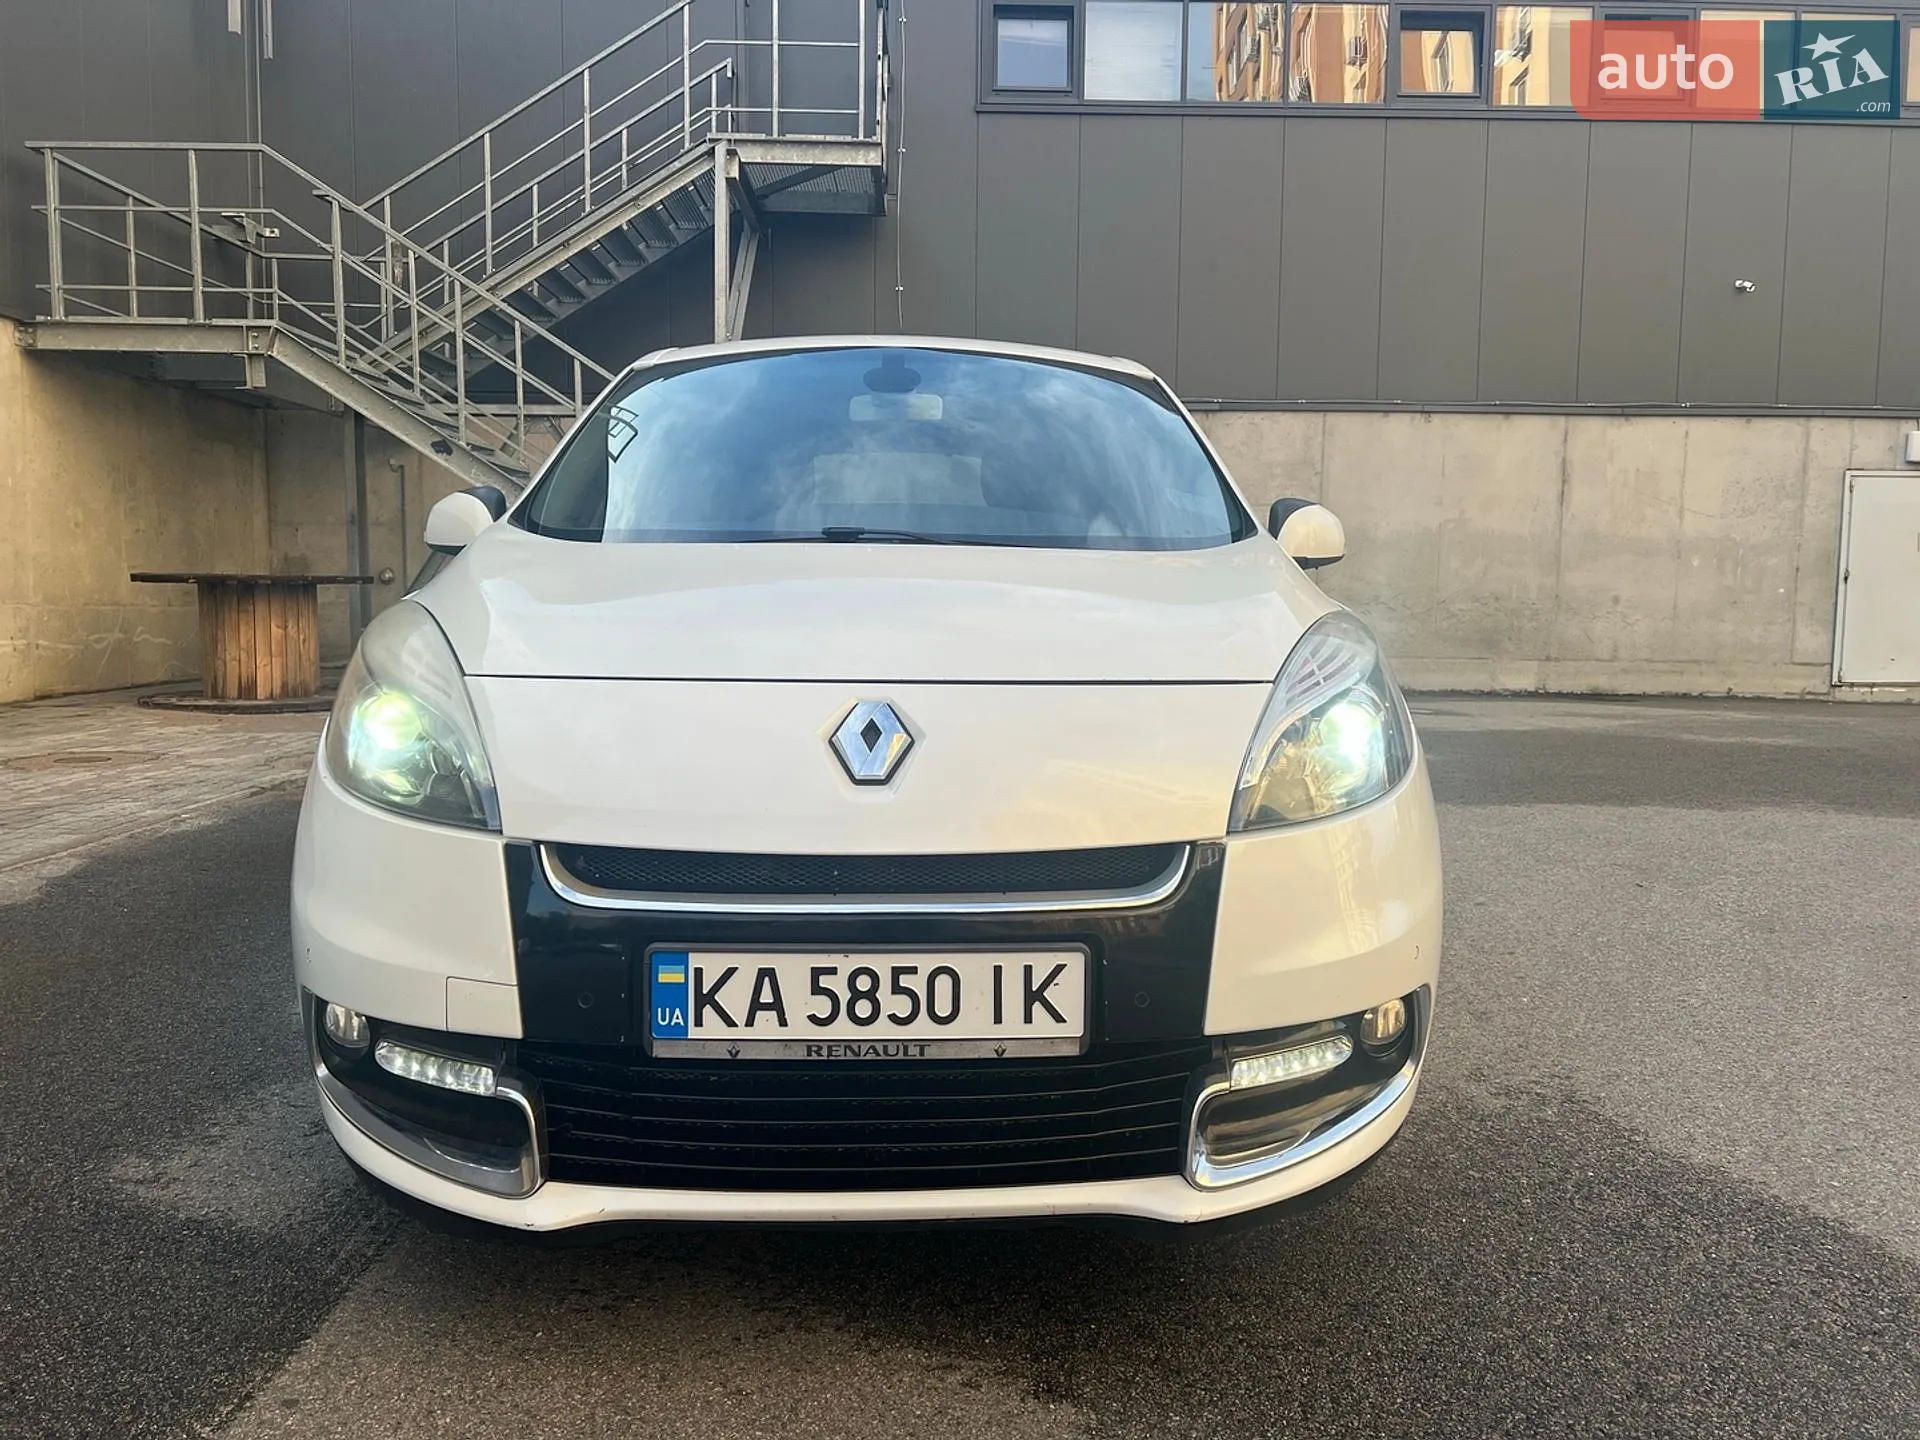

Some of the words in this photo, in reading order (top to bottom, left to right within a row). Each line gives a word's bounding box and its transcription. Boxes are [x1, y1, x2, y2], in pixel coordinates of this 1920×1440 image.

[693, 966, 788, 1028] KA
[806, 965, 960, 1027] 5850
[993, 964, 1068, 1025] IK
[657, 1008, 685, 1027] UA
[805, 1044, 931, 1058] RENAULT
